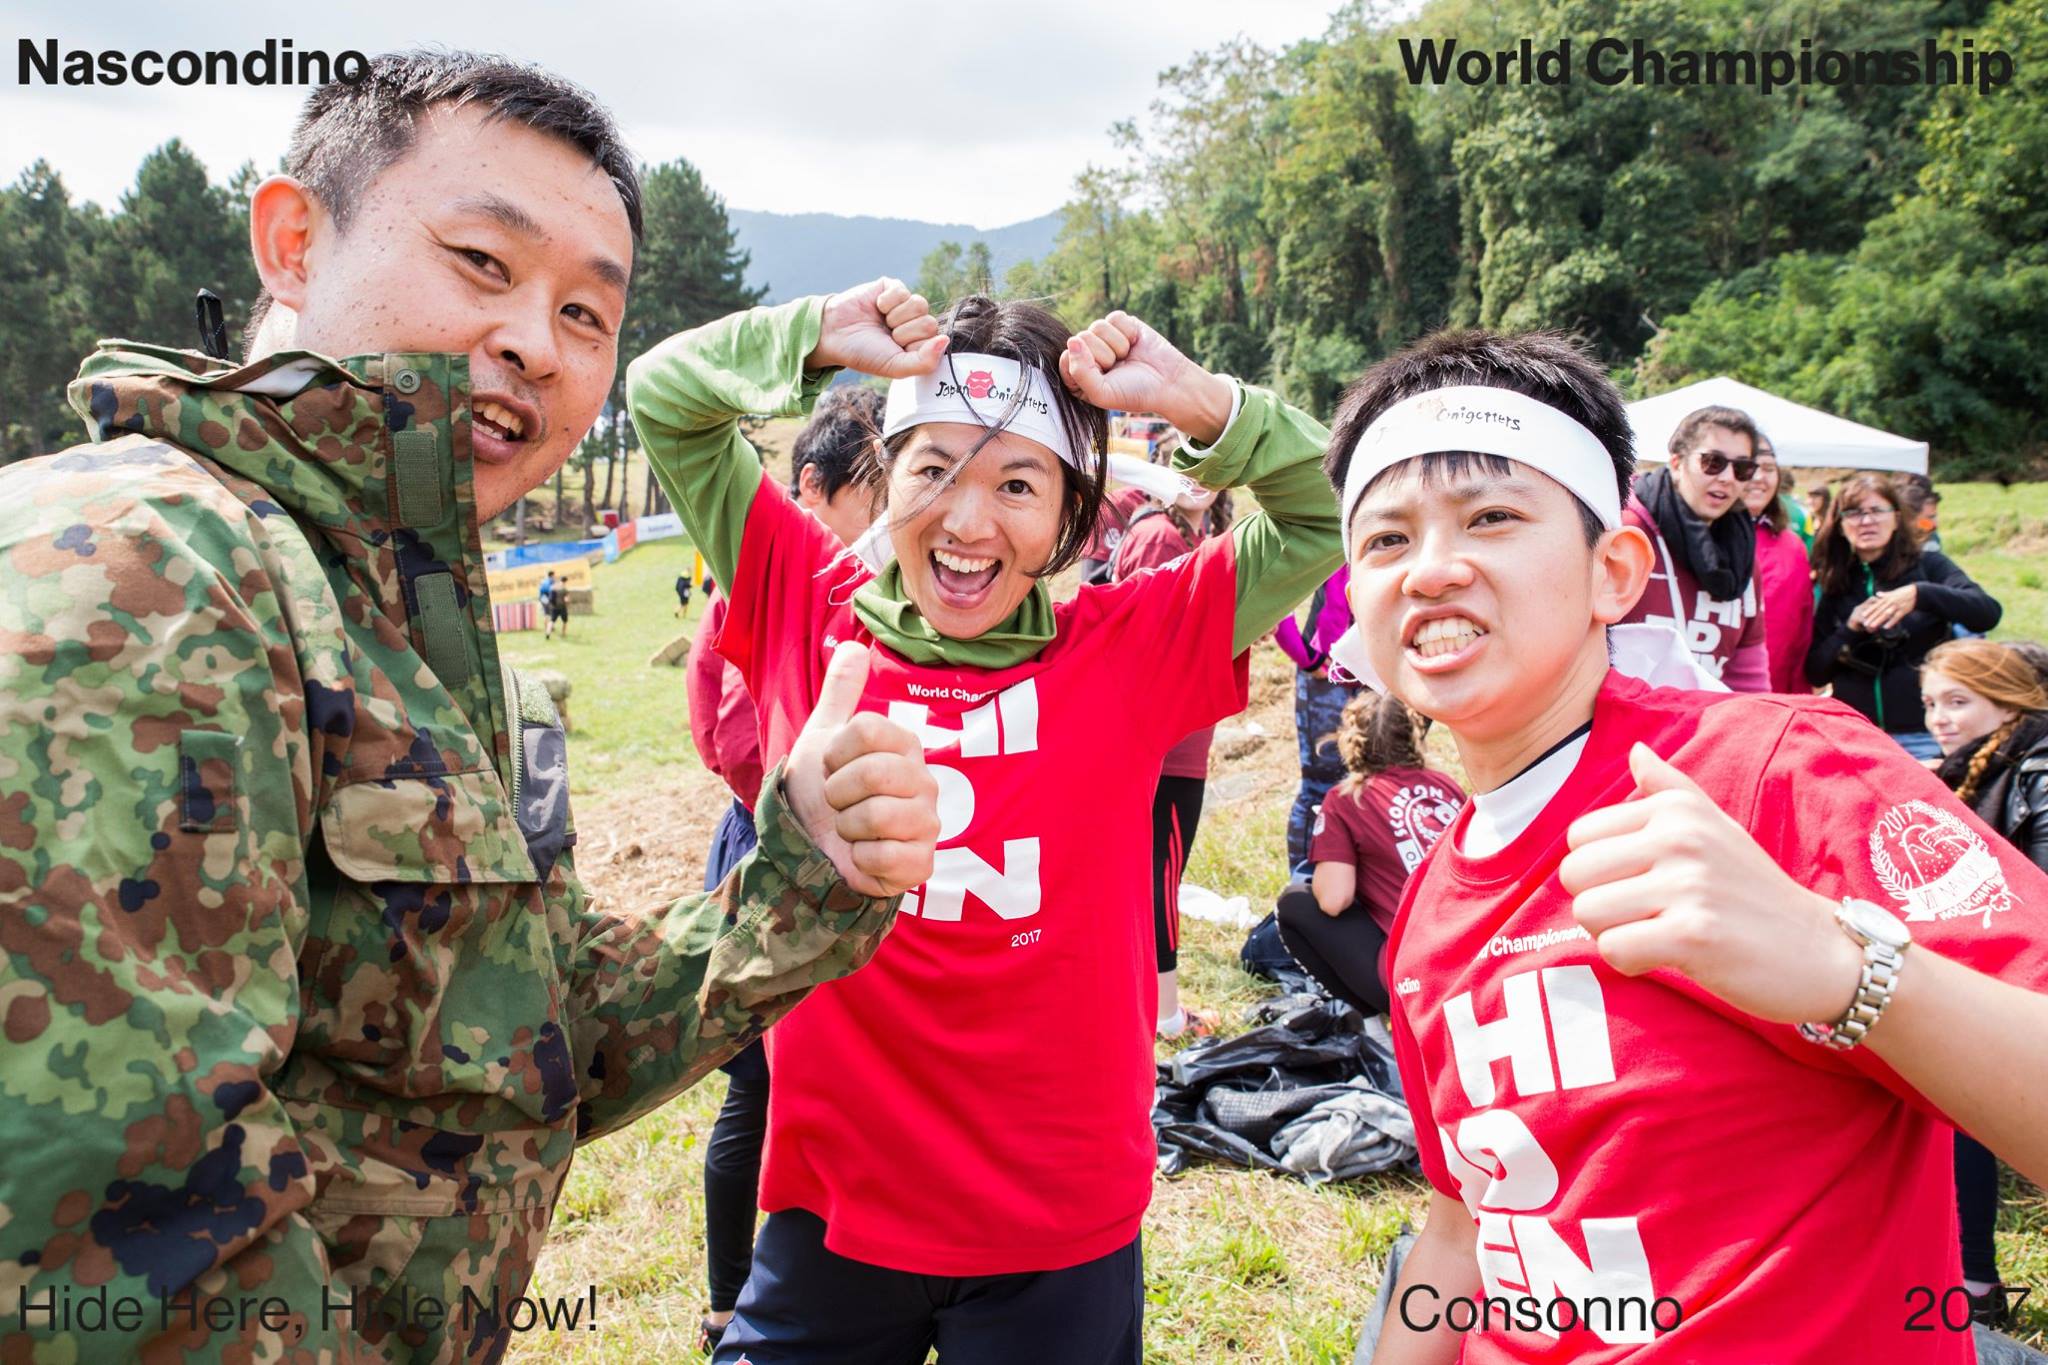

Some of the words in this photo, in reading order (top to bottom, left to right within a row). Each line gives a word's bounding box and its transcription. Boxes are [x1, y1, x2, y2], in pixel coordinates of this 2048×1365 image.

[888, 678, 1038, 758] HI
[907, 683, 949, 698] World
[899, 836, 1042, 922] N
[1011, 929, 1042, 947] 2017
[1443, 965, 1616, 1108] HI
[1476, 1210, 1656, 1345] EN
